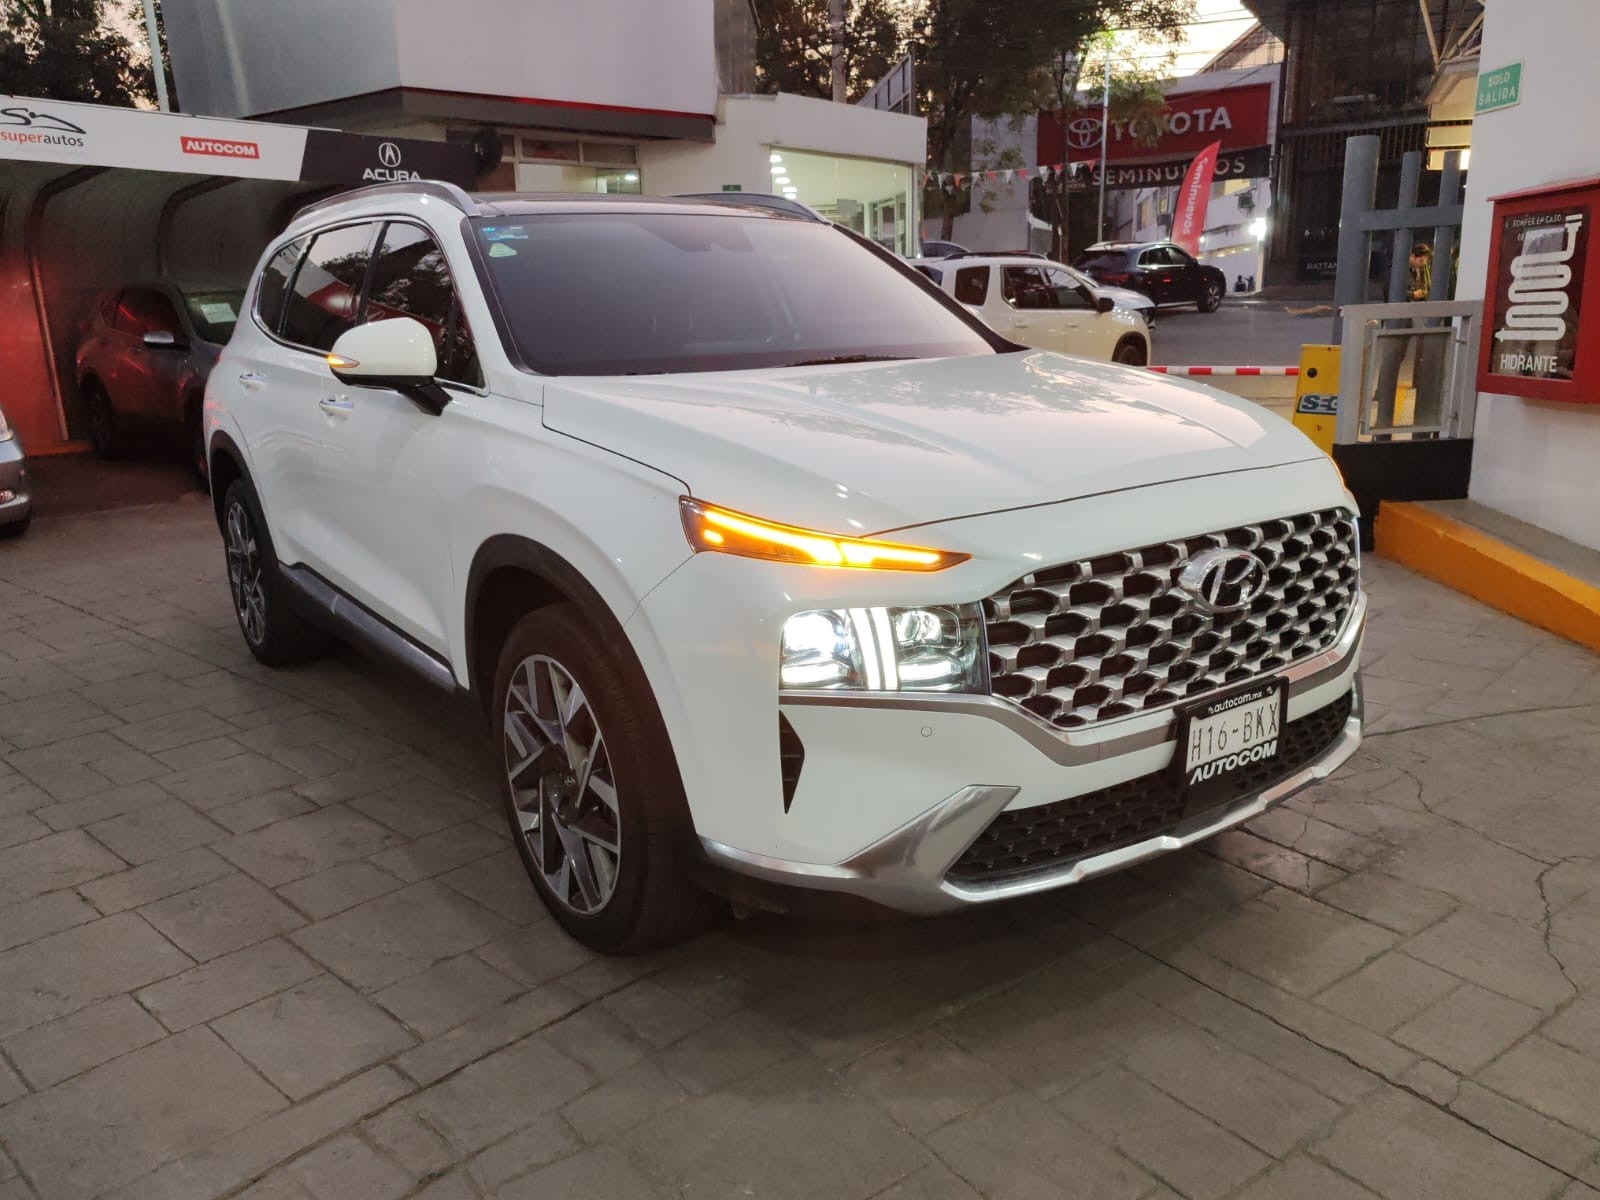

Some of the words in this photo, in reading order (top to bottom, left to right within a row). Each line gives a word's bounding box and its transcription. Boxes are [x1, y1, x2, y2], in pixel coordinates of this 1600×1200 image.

[1487, 71, 1510, 87] SOLO
[1478, 84, 1516, 105] SALIDA
[0, 131, 84, 147] superautos
[186, 139, 256, 156] AUTOCOM
[362, 167, 421, 181] ACURA
[1182, 156, 1208, 235] Seminuevos
[1545, 215, 1562, 224] CASO
[1501, 353, 1559, 373] HIDRANTE
[1214, 691, 1262, 713] autocom.mx
[1191, 702, 1278, 761] H16-BKX
[1189, 739, 1278, 786] AUTOCOM
